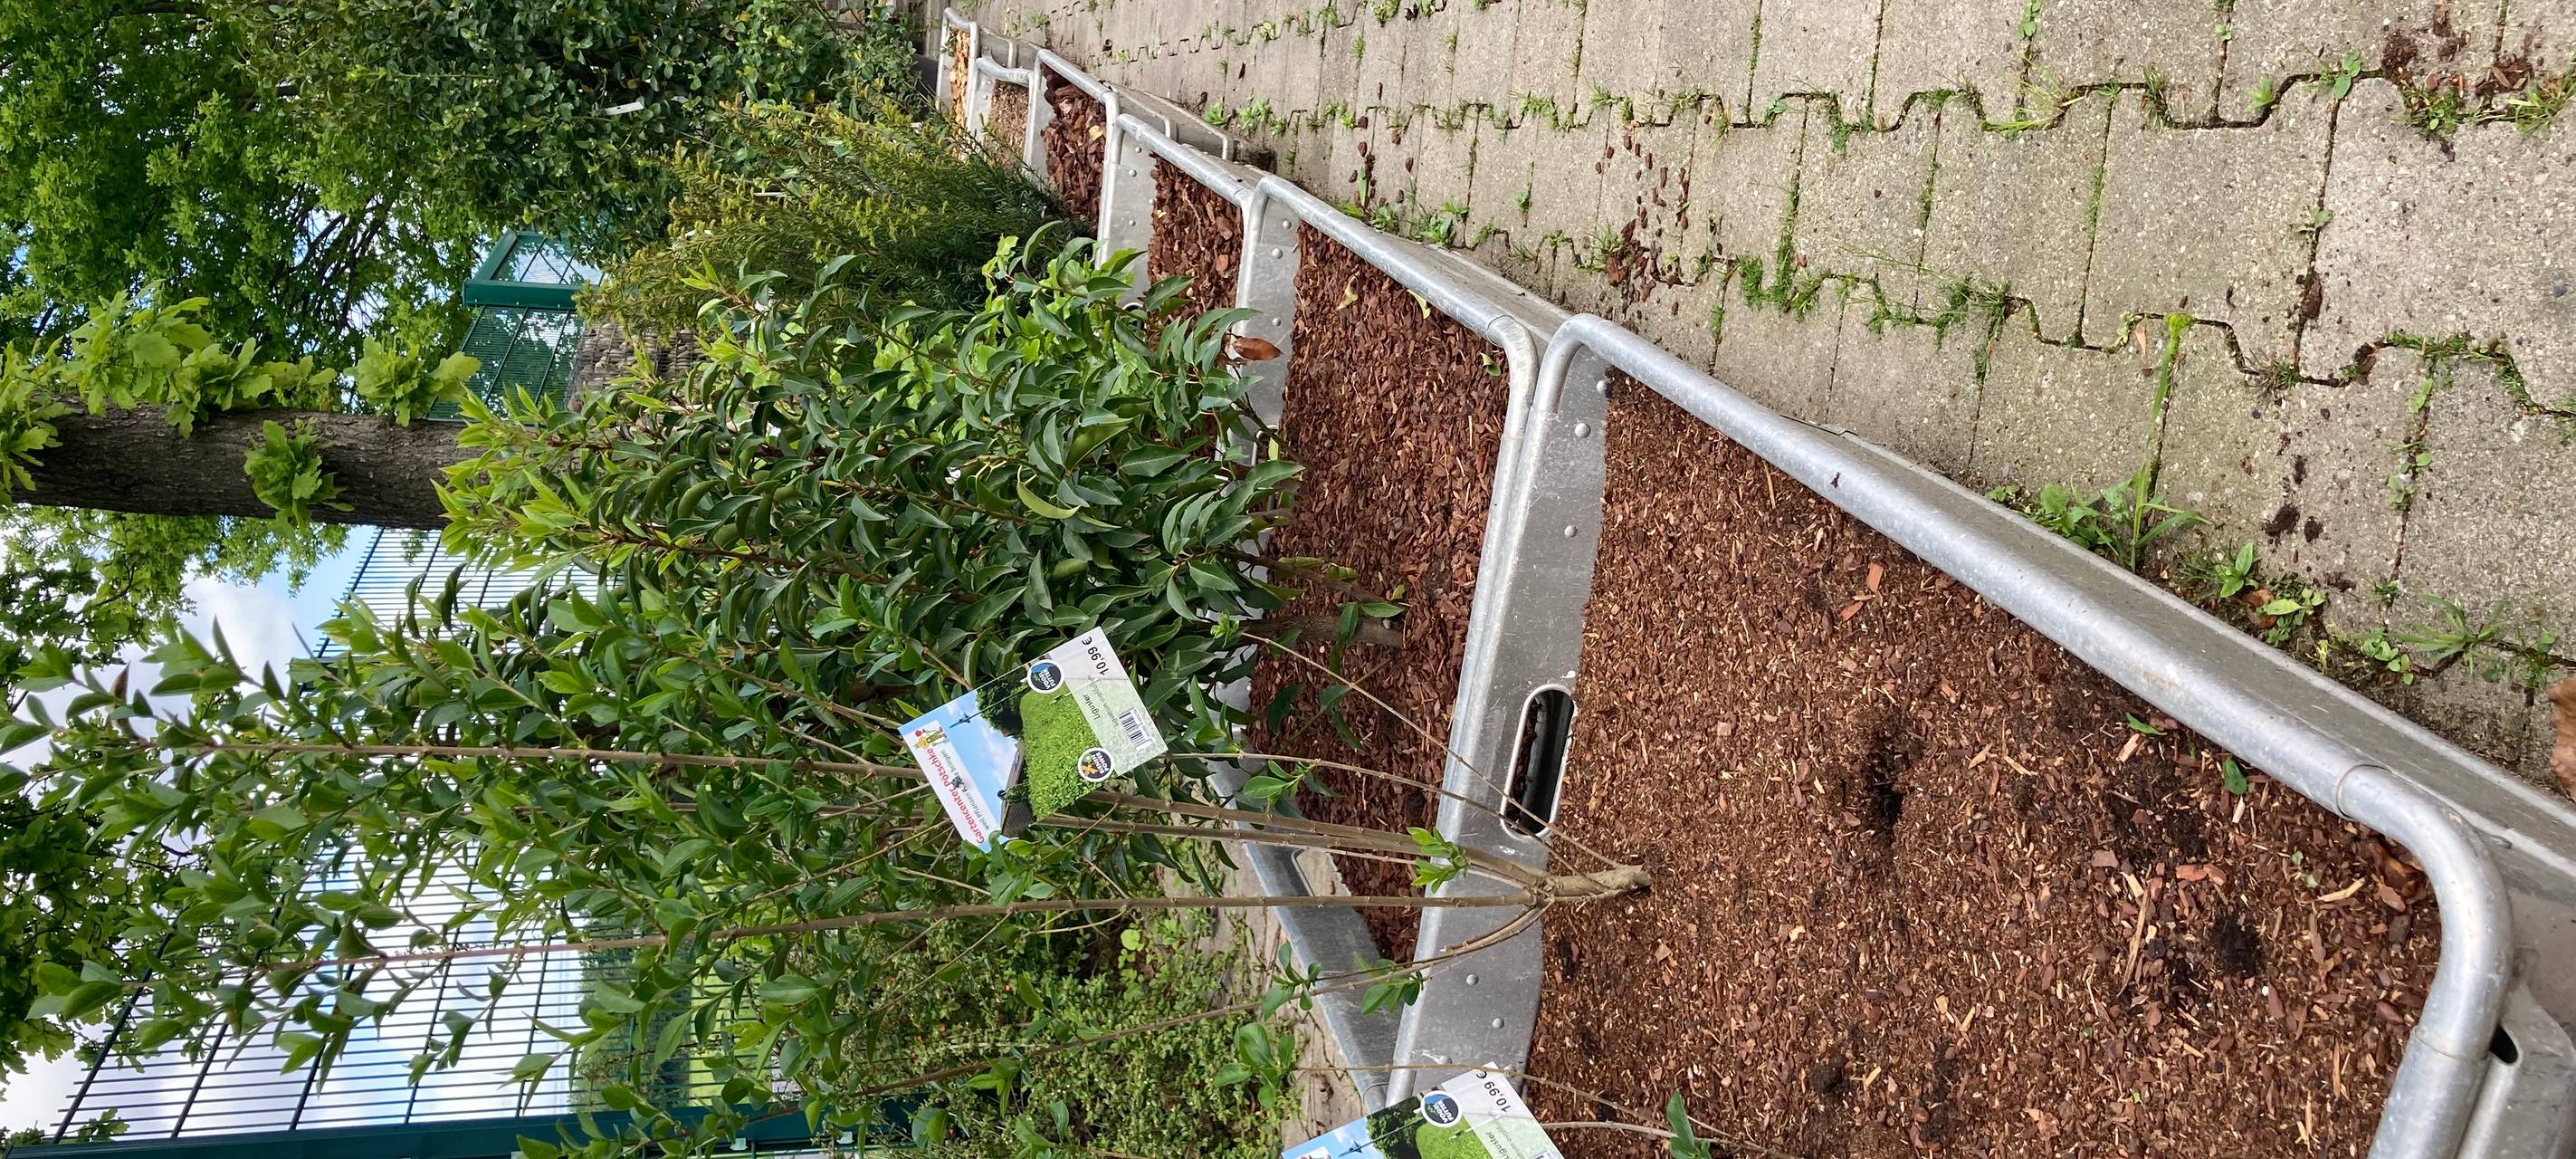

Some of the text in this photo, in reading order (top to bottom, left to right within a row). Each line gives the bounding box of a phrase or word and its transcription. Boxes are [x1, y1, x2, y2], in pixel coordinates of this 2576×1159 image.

[1081, 635, 1111, 676] 10,99 €
[1080, 691, 1102, 721] Liguster
[947, 785, 986, 845] Gartencenter
[1483, 1079, 1511, 1114] 10,99
[1485, 1129, 1511, 1159] iguster
